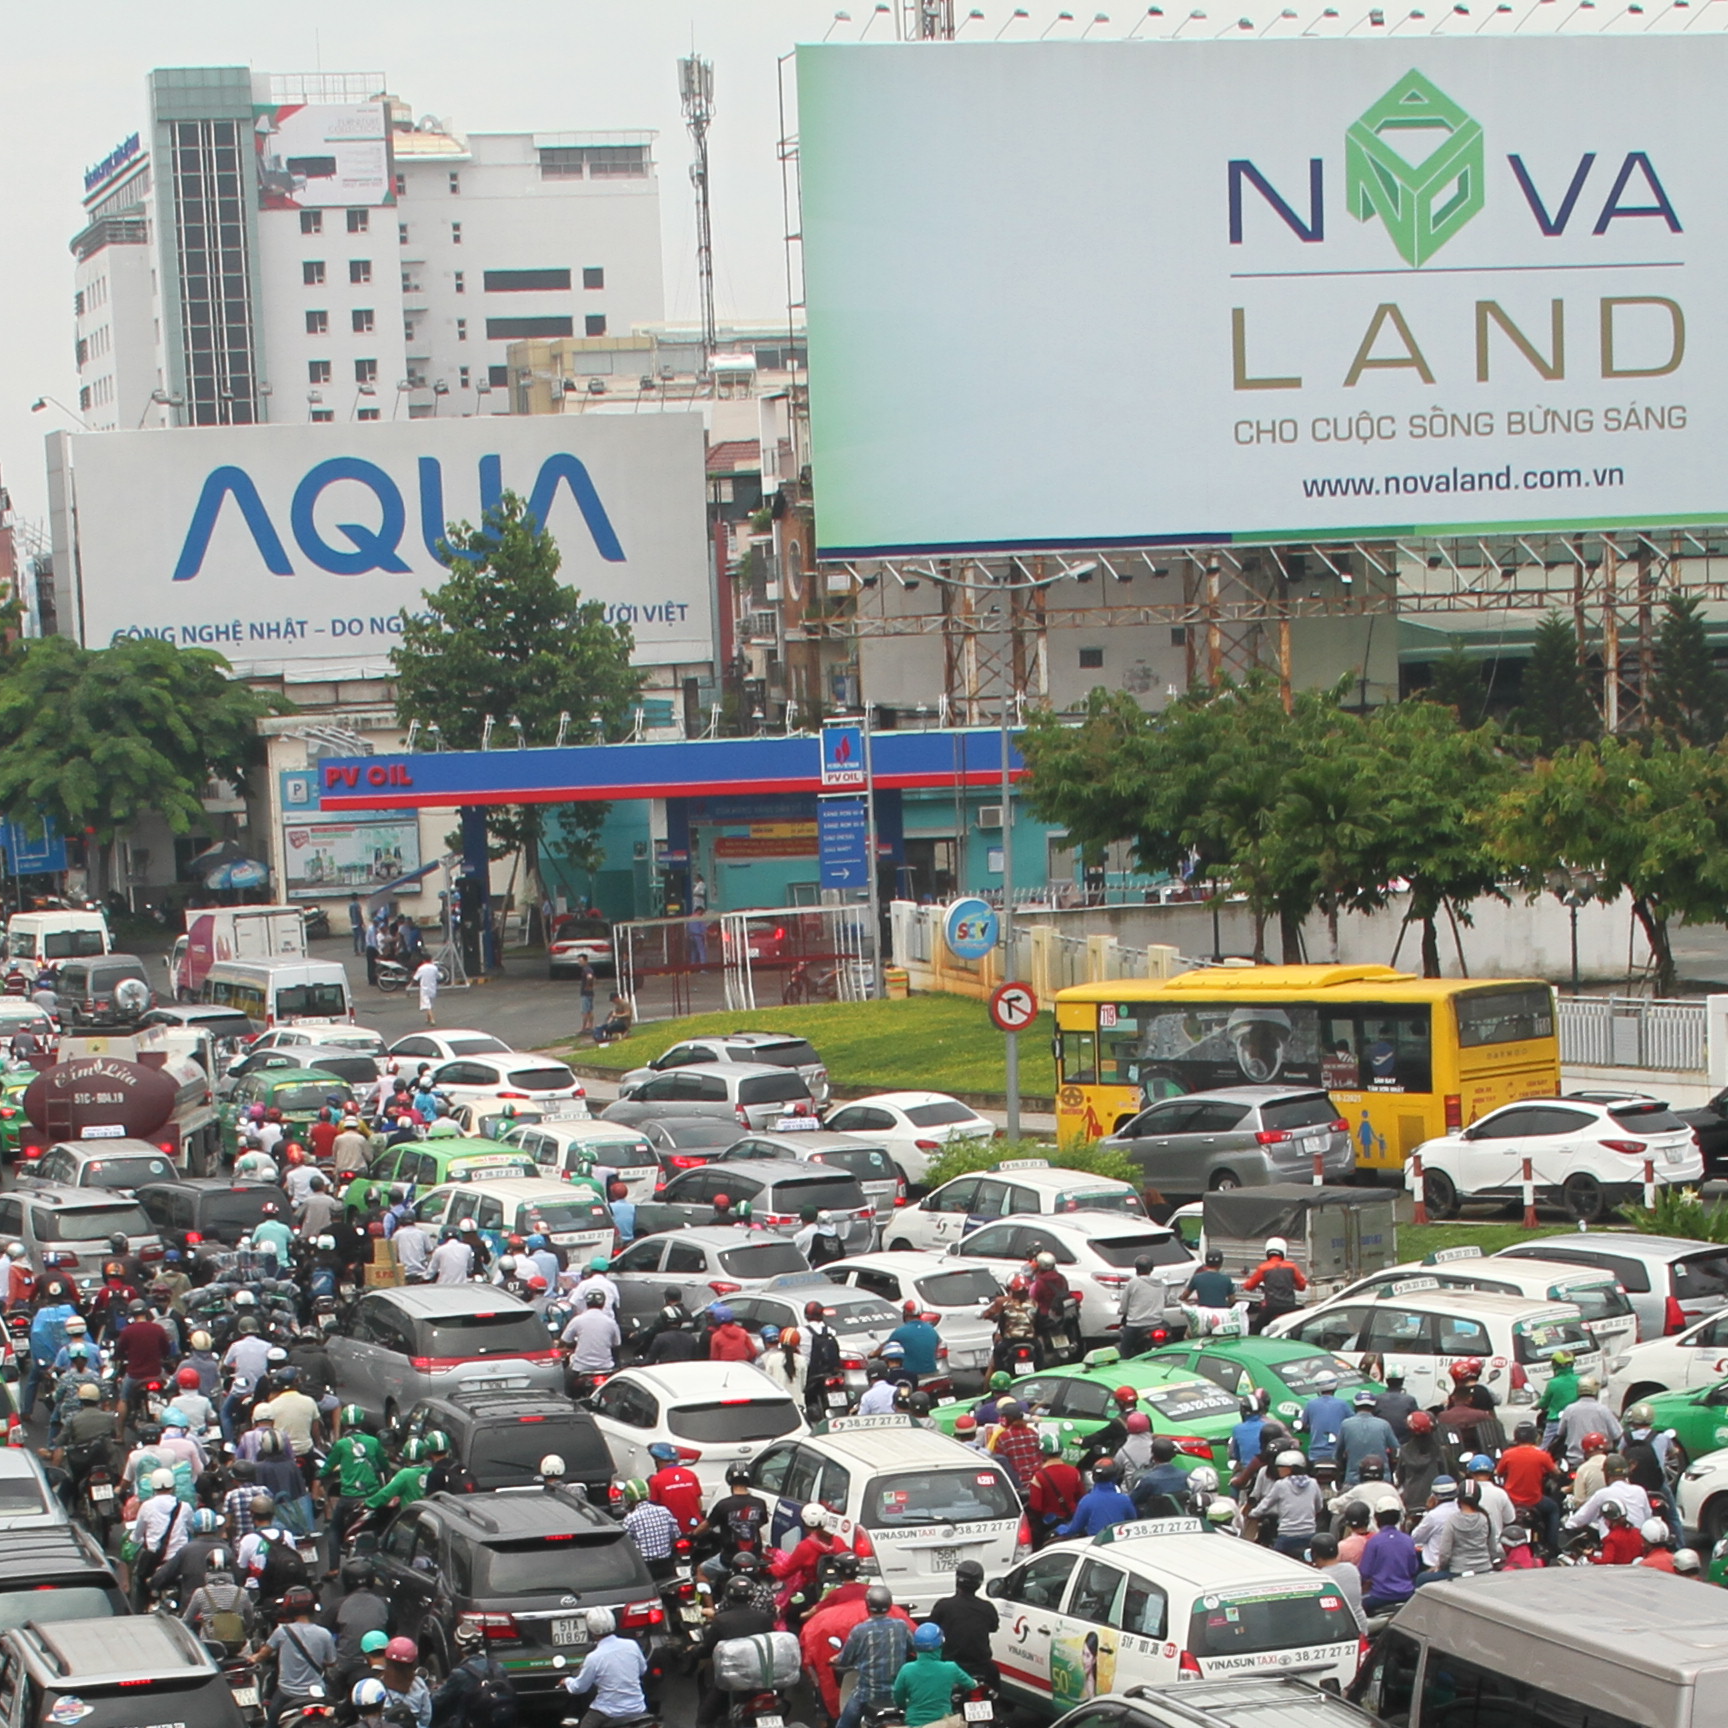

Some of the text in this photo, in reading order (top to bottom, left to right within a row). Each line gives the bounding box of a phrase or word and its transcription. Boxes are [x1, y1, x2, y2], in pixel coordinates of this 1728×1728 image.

[1232, 295, 1686, 391] LAND
[1234, 419, 1299, 446] CHO
[1311, 411, 1396, 446] CUỘC
[1603, 401, 1688, 432] SÁNG
[1302, 465, 1625, 498] www.novaland.com.vn
[172, 452, 627, 581] AQUA
[642, 601, 689, 627] VIỆT
[181, 619, 243, 647] NGHỆ
[249, 616, 309, 645] NHẬT
[330, 614, 364, 636] DO
[325, 764, 414, 789] PV OIL
[827, 772, 860, 783] PV OIL
[293, 783, 303, 797] P
[1133, 1520, 1199, 1536] 38.27 27 27
[554, 1630, 588, 1644] 018.67
[559, 1618, 579, 1631] 51A
[1328, 1645, 1342, 1659] 27
[1344, 1643, 1357, 1657] 27
